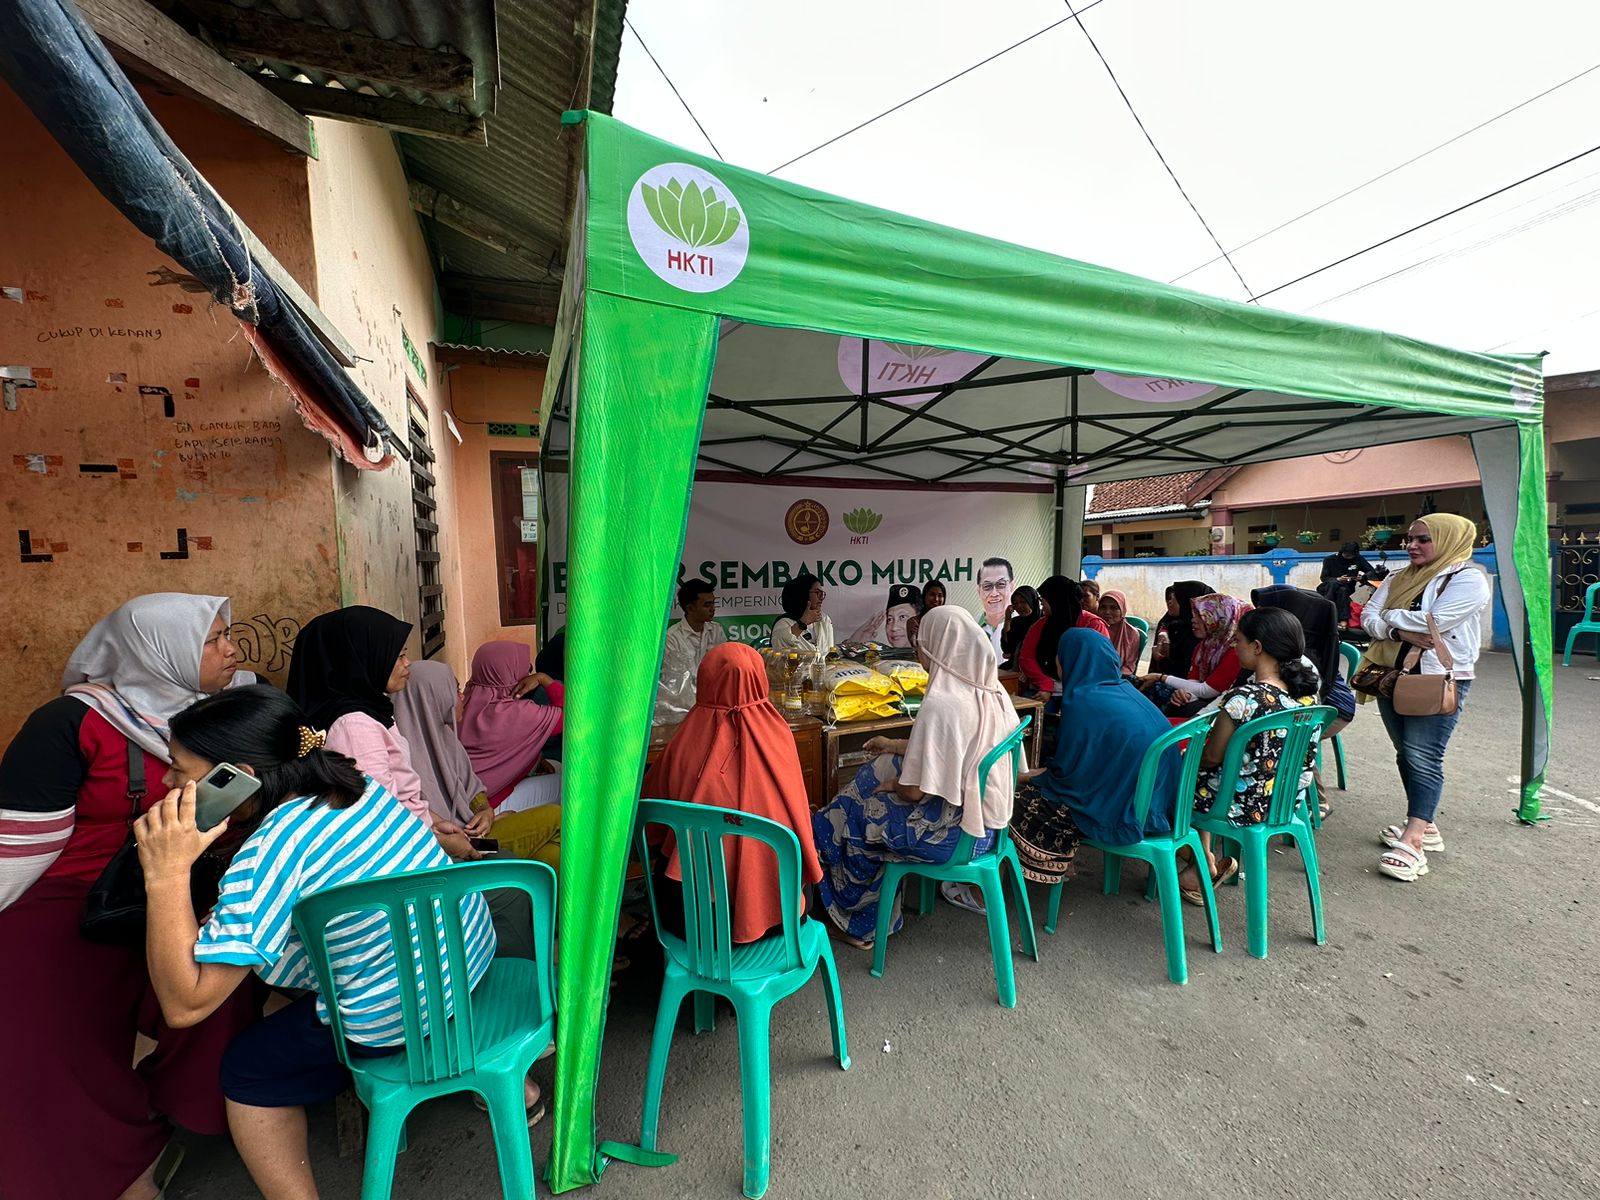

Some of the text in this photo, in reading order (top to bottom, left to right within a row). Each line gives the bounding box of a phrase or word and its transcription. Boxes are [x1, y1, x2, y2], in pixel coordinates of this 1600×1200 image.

[667, 248, 714, 277] HKTI
[89, 327, 104, 337] DI
[849, 536, 869, 545] HKTI
[871, 557, 973, 585] MURAH
